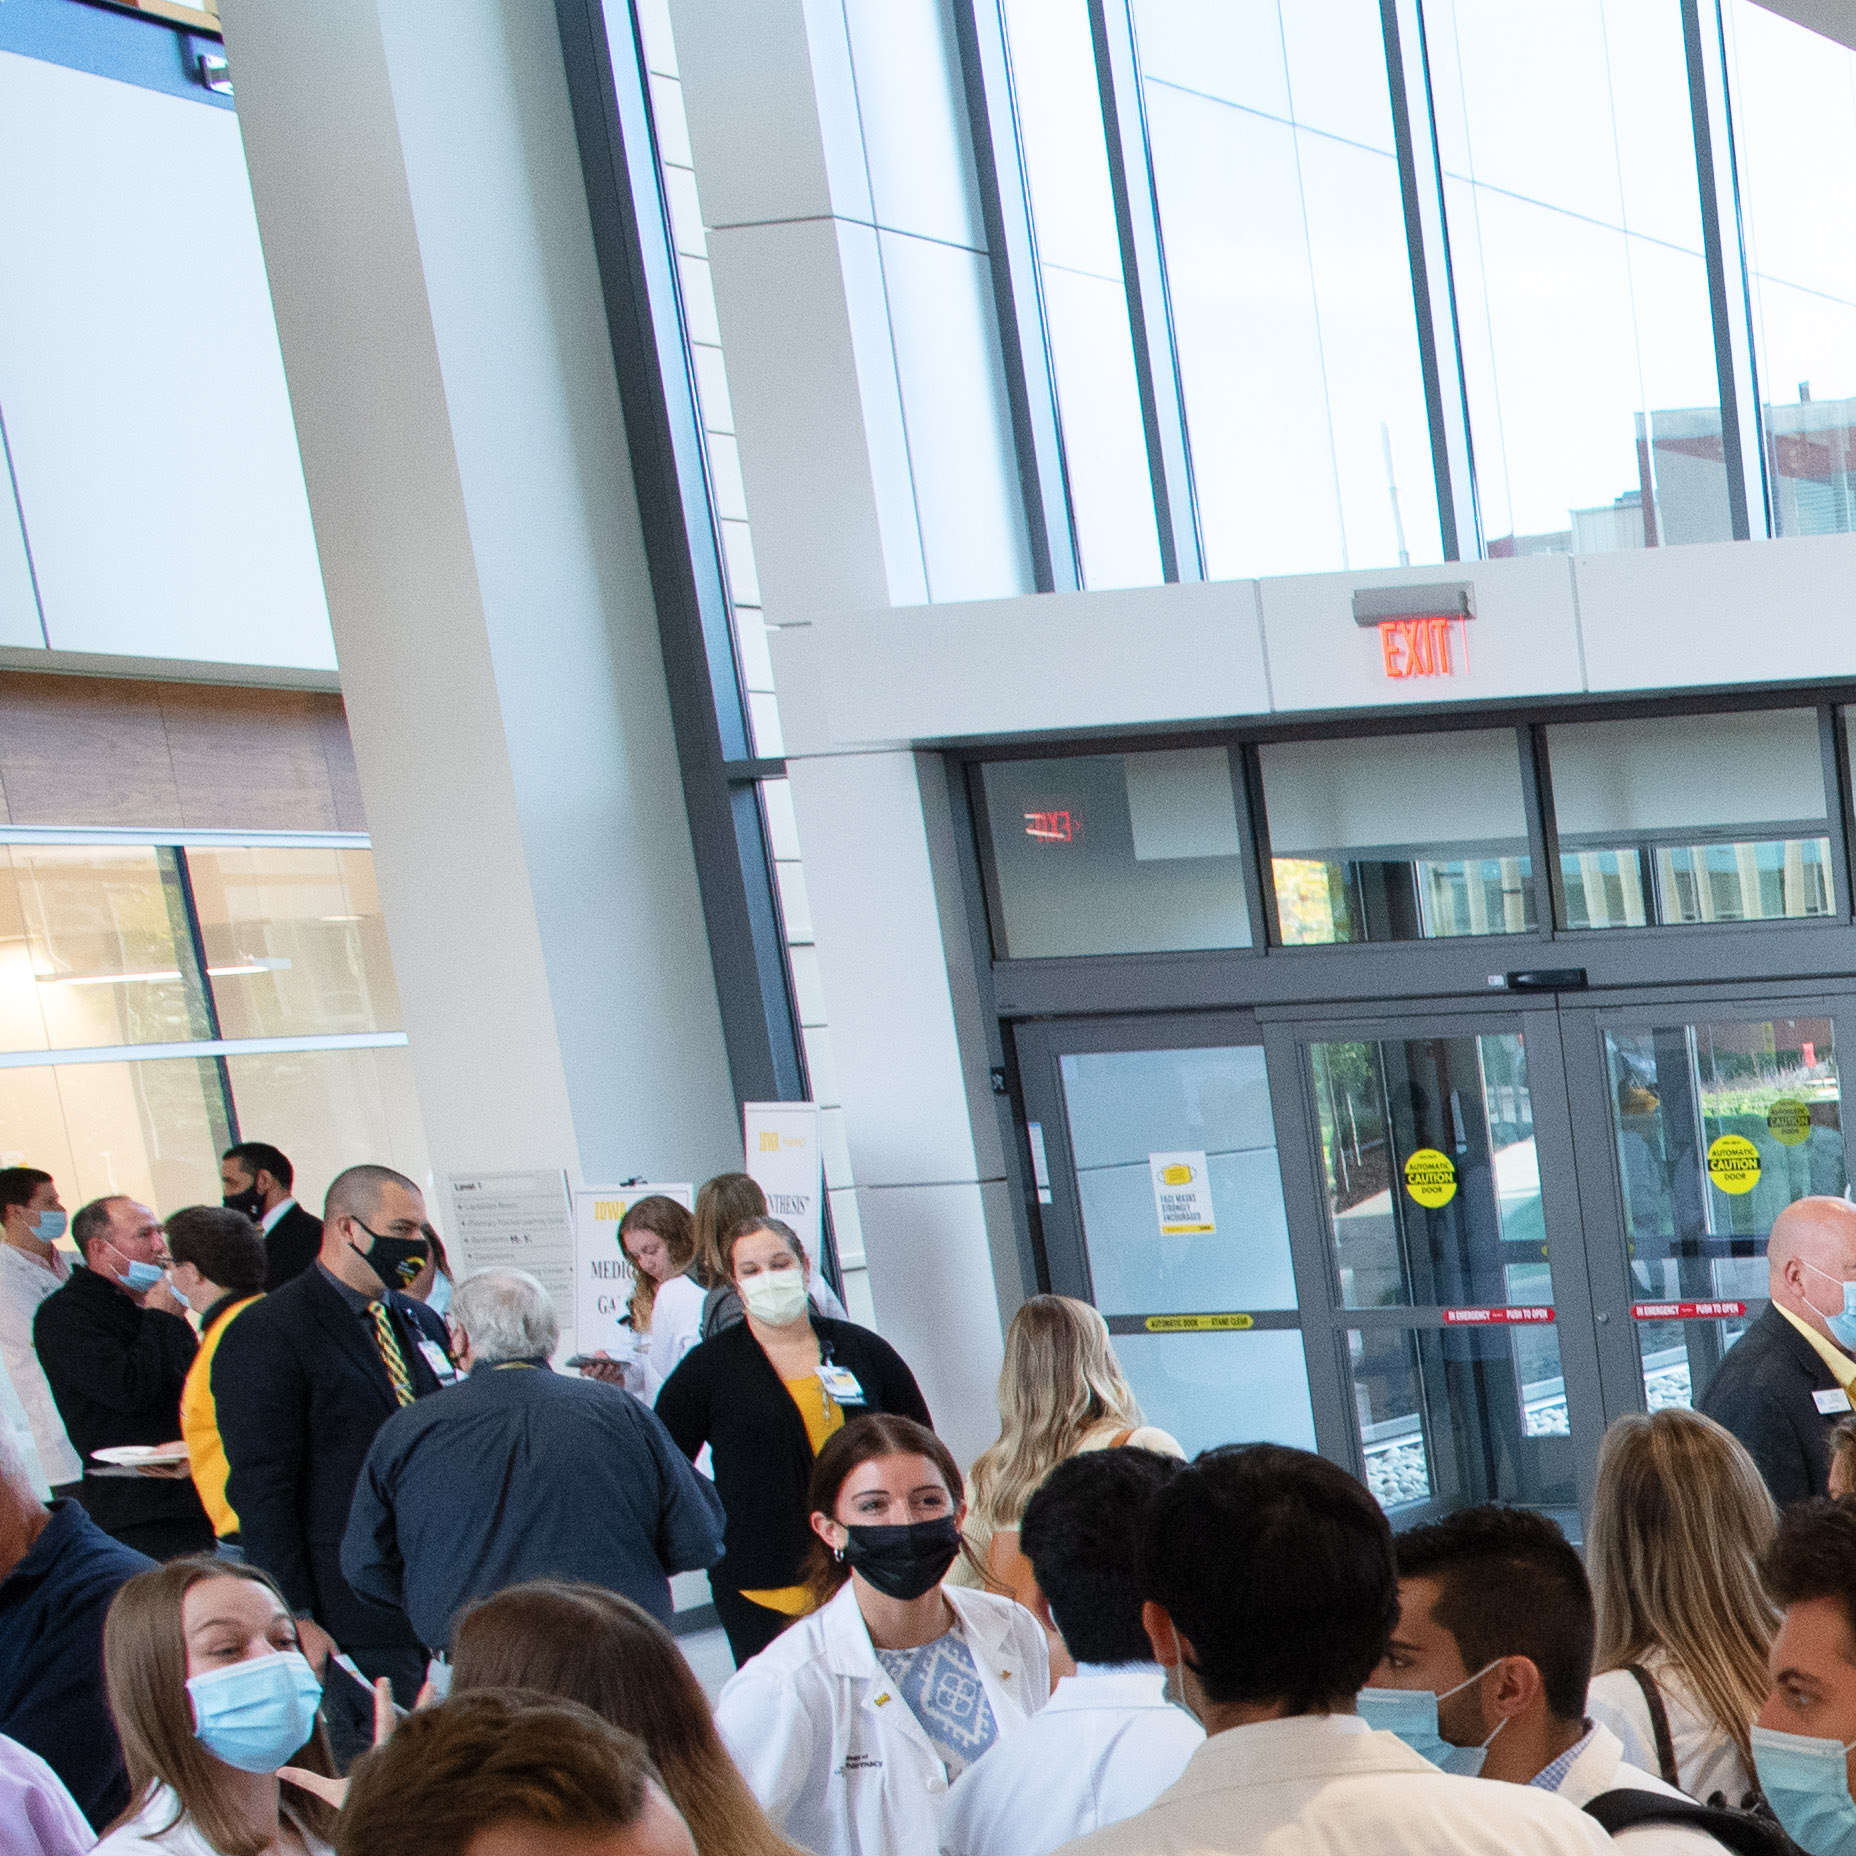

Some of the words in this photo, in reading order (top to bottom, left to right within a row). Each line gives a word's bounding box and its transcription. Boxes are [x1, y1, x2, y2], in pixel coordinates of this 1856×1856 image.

[1377, 616, 1448, 678] EXIT
[1711, 1148, 1754, 1157] AUTOMATIC
[1710, 1158, 1758, 1172] CAUTION
[1408, 1172, 1454, 1185] CAUTION
[1723, 1172, 1747, 1181] DOOR
